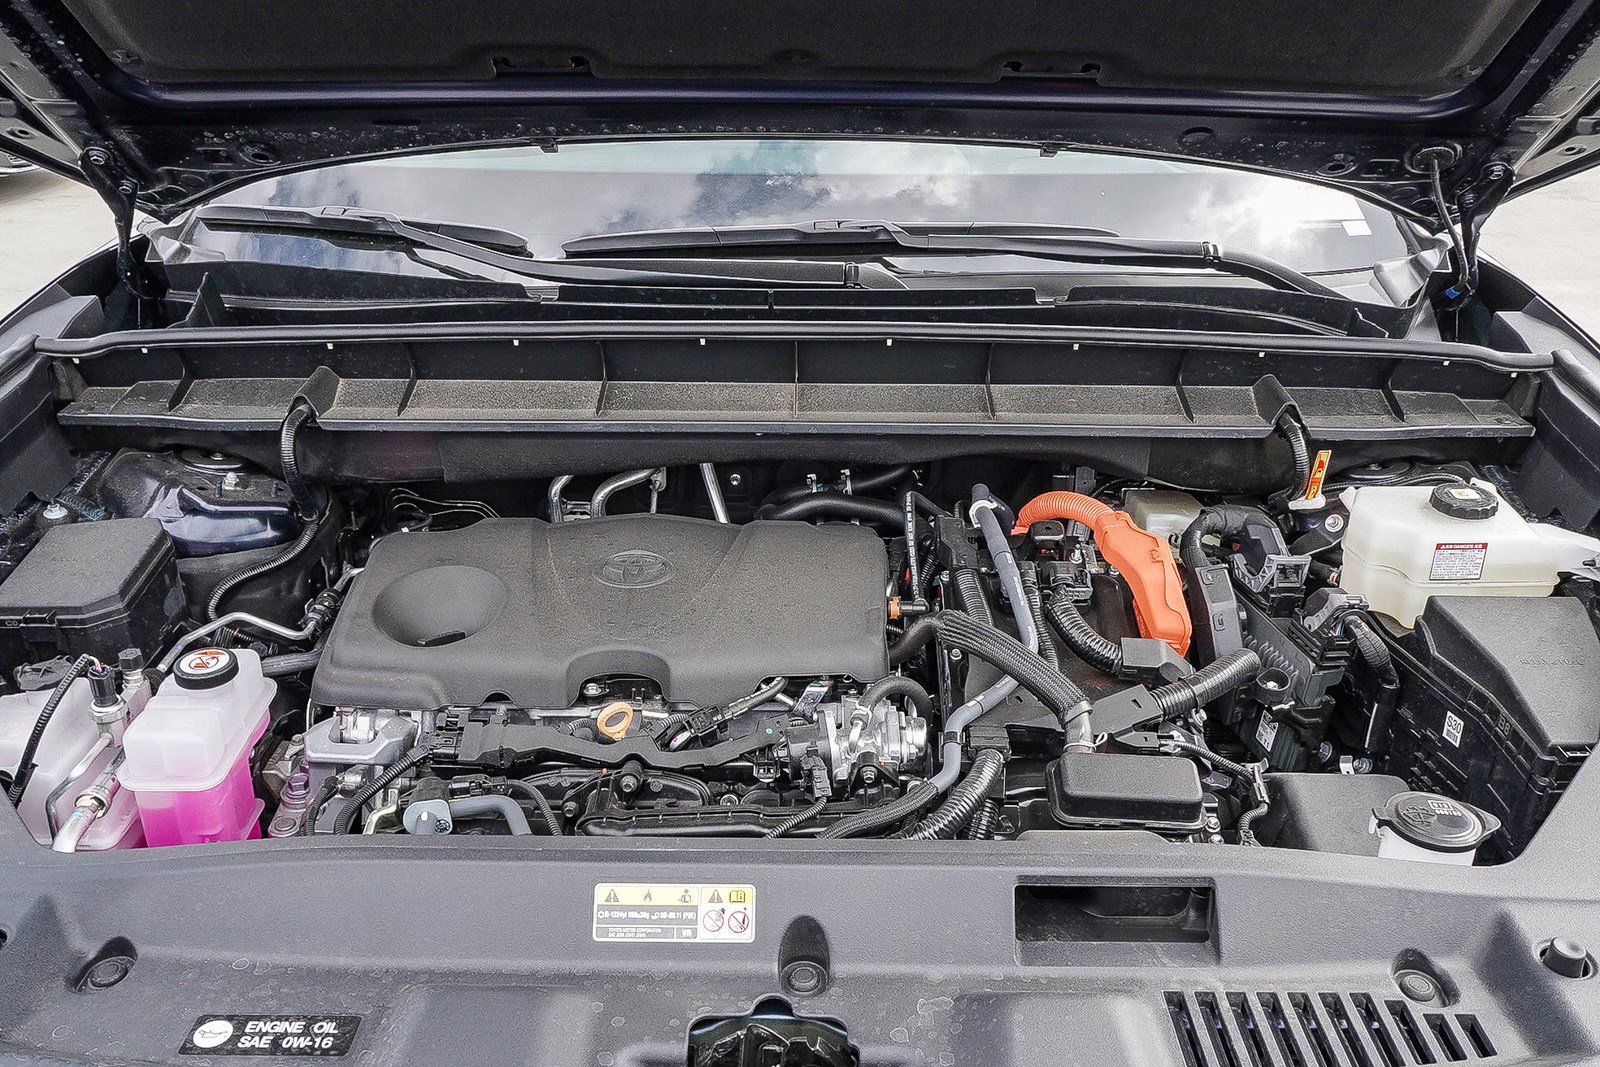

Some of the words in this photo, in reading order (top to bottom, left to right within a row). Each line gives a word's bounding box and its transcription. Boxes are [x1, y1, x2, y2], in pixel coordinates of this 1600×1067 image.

[1447, 715, 1461, 734] S30
[244, 1021, 306, 1033] ENGINE
[313, 1021, 339, 1034] OIL
[237, 1035, 274, 1048] SAE
[281, 1036, 334, 1049] 0W-16
